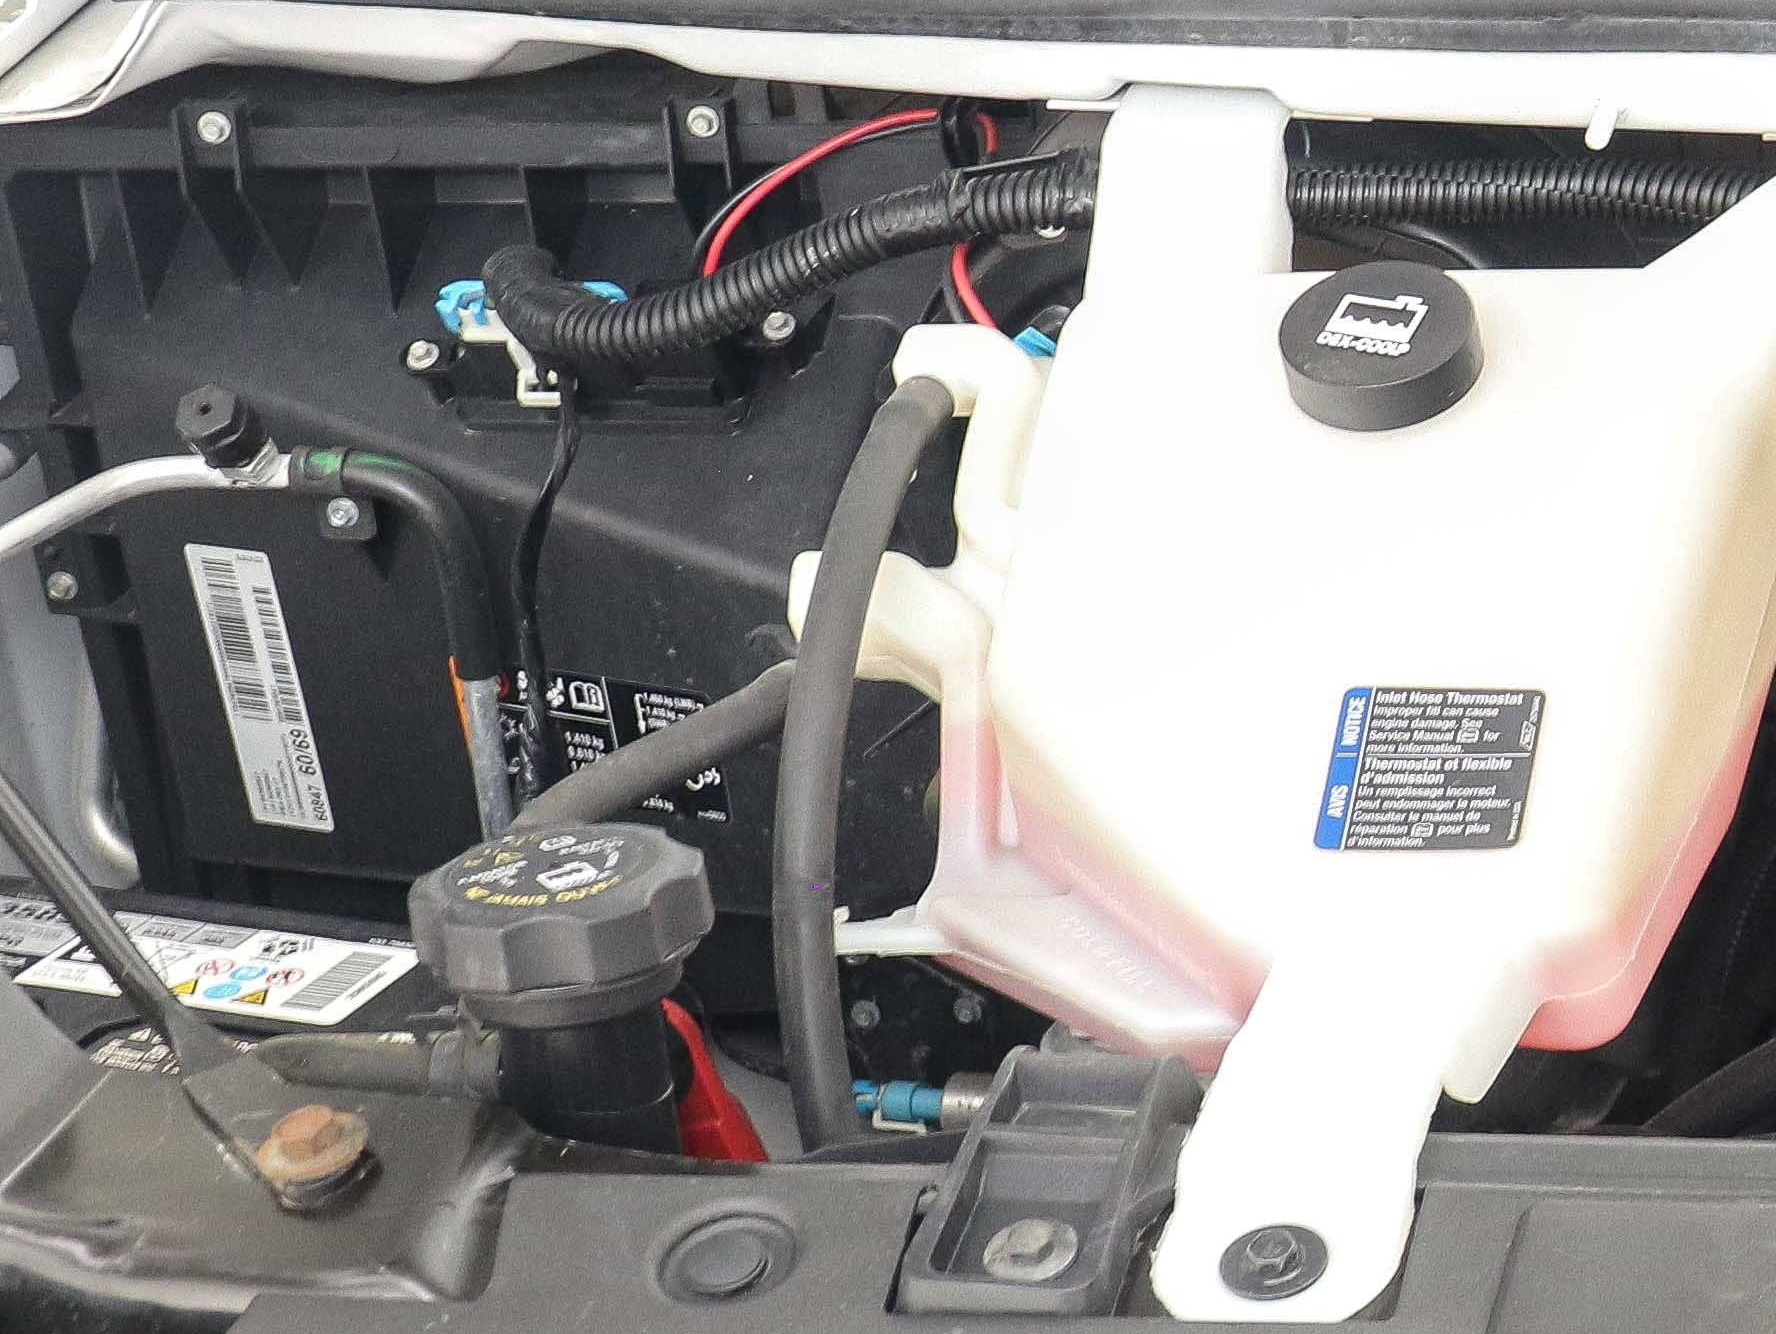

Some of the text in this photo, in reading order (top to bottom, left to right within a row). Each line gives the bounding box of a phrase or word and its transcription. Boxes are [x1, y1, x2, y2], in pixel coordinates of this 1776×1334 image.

[1376, 691, 1524, 705] Inlet Hose Thermostat
[1373, 705, 1499, 718] Improper fill can cause
[1341, 696, 1367, 746] NOTICE
[1371, 718, 1409, 730] engine
[1461, 718, 1483, 729] See
[1369, 730, 1500, 741] Service Manual for
[290, 730, 318, 776] 60/69
[1366, 742, 1465, 754] more information.
[1364, 757, 1512, 771] Thermostat et flexible
[1361, 771, 1445, 785] d'admission
[1358, 785, 1496, 799] Un remplissage incorrect
[308, 784, 328, 822] 60847
[1327, 785, 1348, 818] AVIS
[1355, 799, 1380, 810] peut
[1382, 798, 1455, 811] endommager
[1457, 799, 1468, 809] le
[1353, 810, 1481, 822] Consulter le manuel de
[1350, 823, 1490, 836] réparation pour plus
